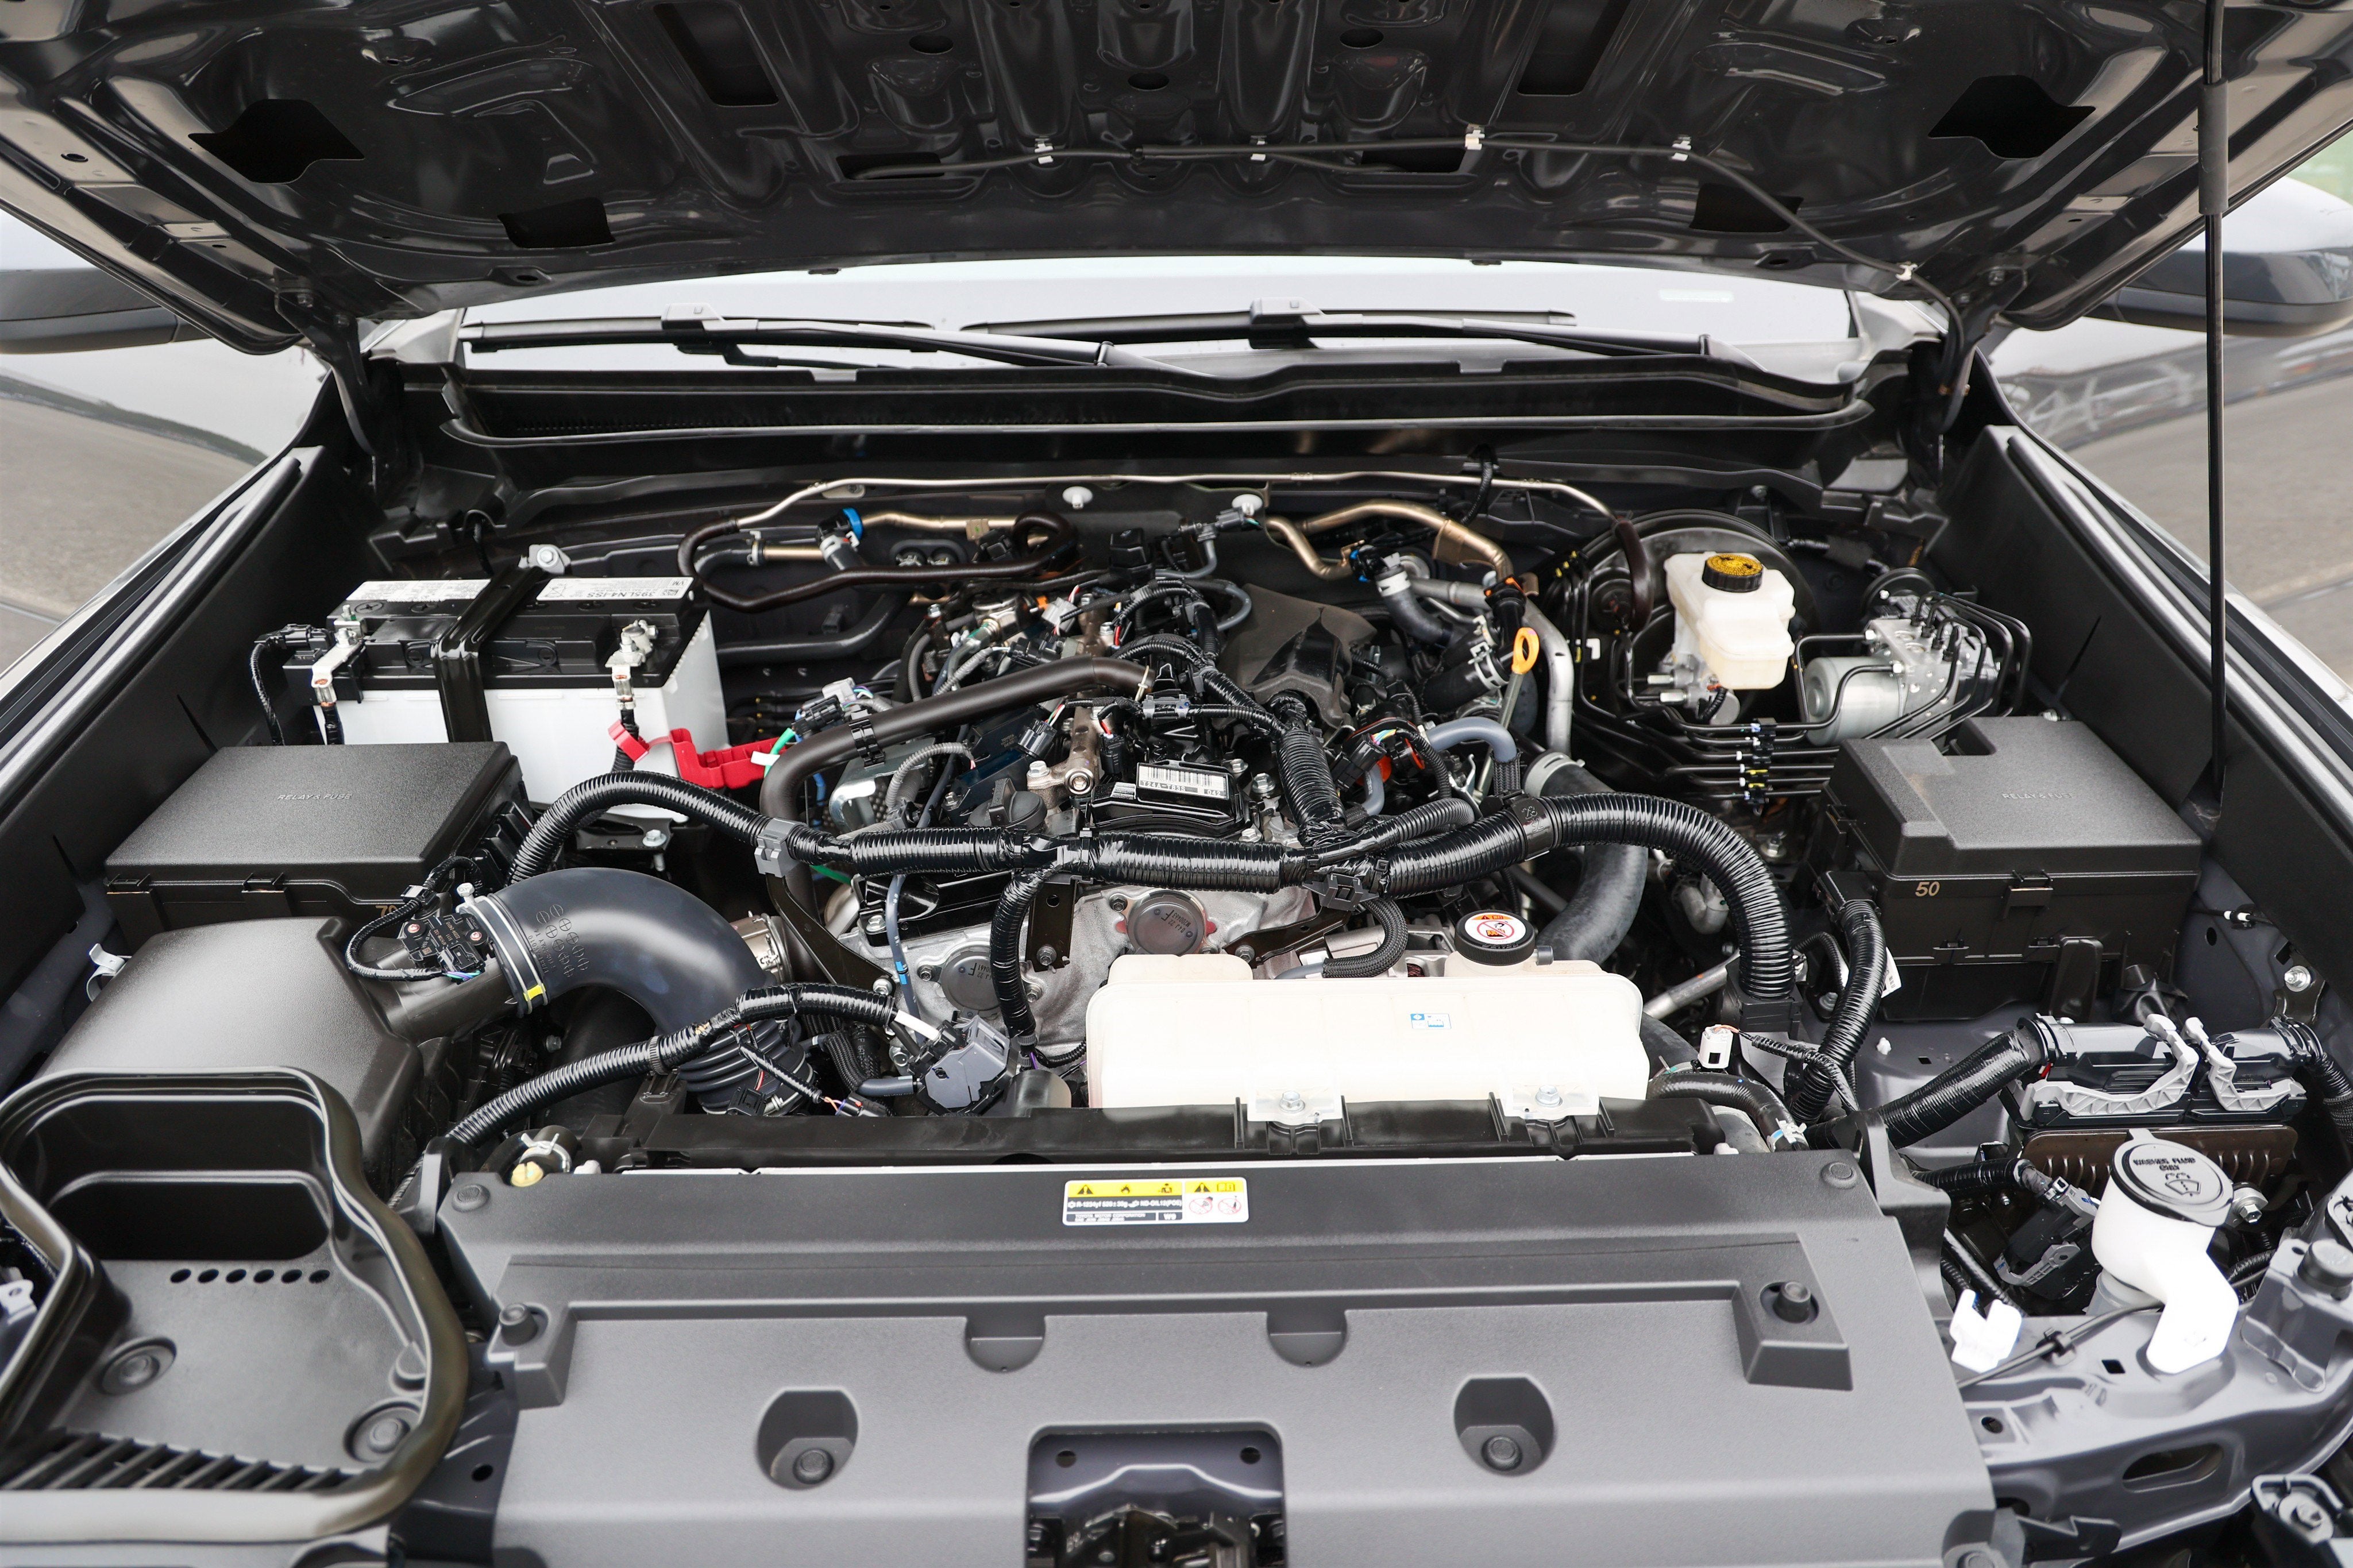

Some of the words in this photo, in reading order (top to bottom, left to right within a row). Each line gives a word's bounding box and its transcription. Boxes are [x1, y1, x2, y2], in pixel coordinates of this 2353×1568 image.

[1142, 781, 1186, 791] T24A-T83S
[1915, 881, 1941, 897] 50
[1160, 910, 1174, 921] F
[968, 963, 977, 976] F
